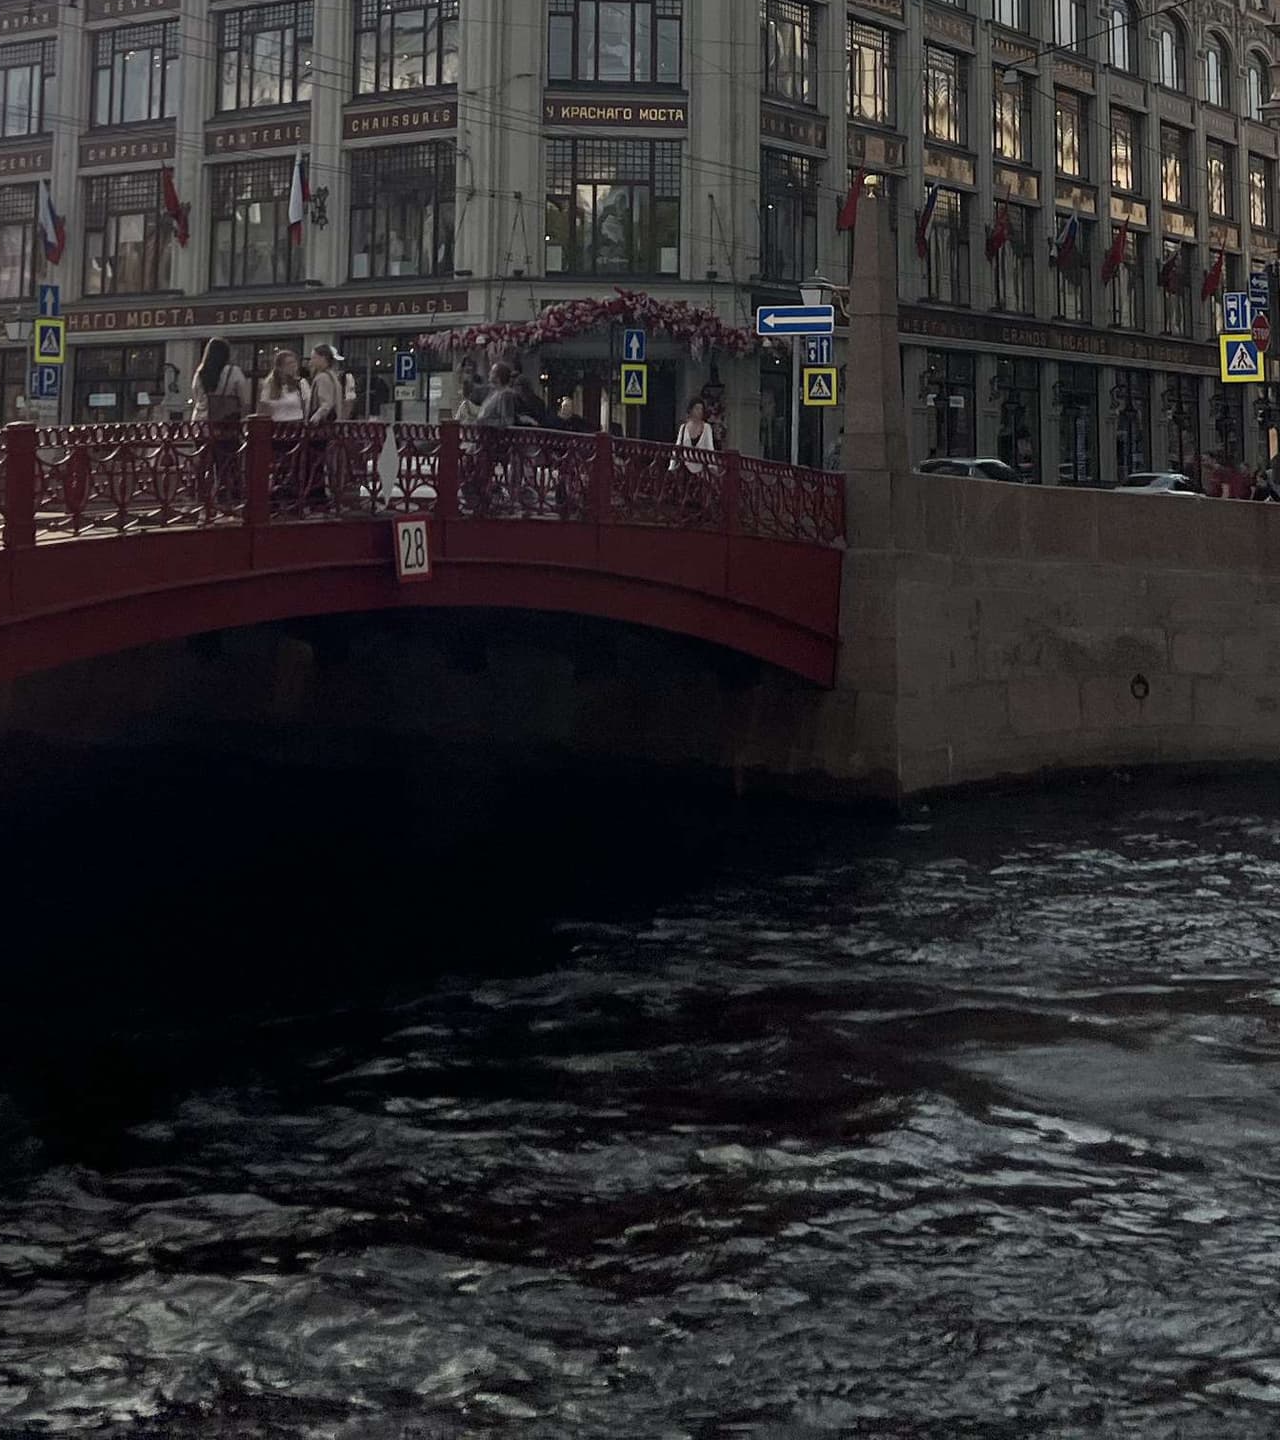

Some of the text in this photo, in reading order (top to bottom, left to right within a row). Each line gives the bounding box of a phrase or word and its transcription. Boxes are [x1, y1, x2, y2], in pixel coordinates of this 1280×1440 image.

[546, 105, 684, 122] У КРАСНАГО МОСТА
[69, 314, 116, 331] НАГО
[127, 309, 195, 328] МОСТА
[1252, 327, 1269, 341] STOP
[401, 355, 413, 378] P
[43, 368, 56, 393] P
[402, 527, 424, 568] 28
